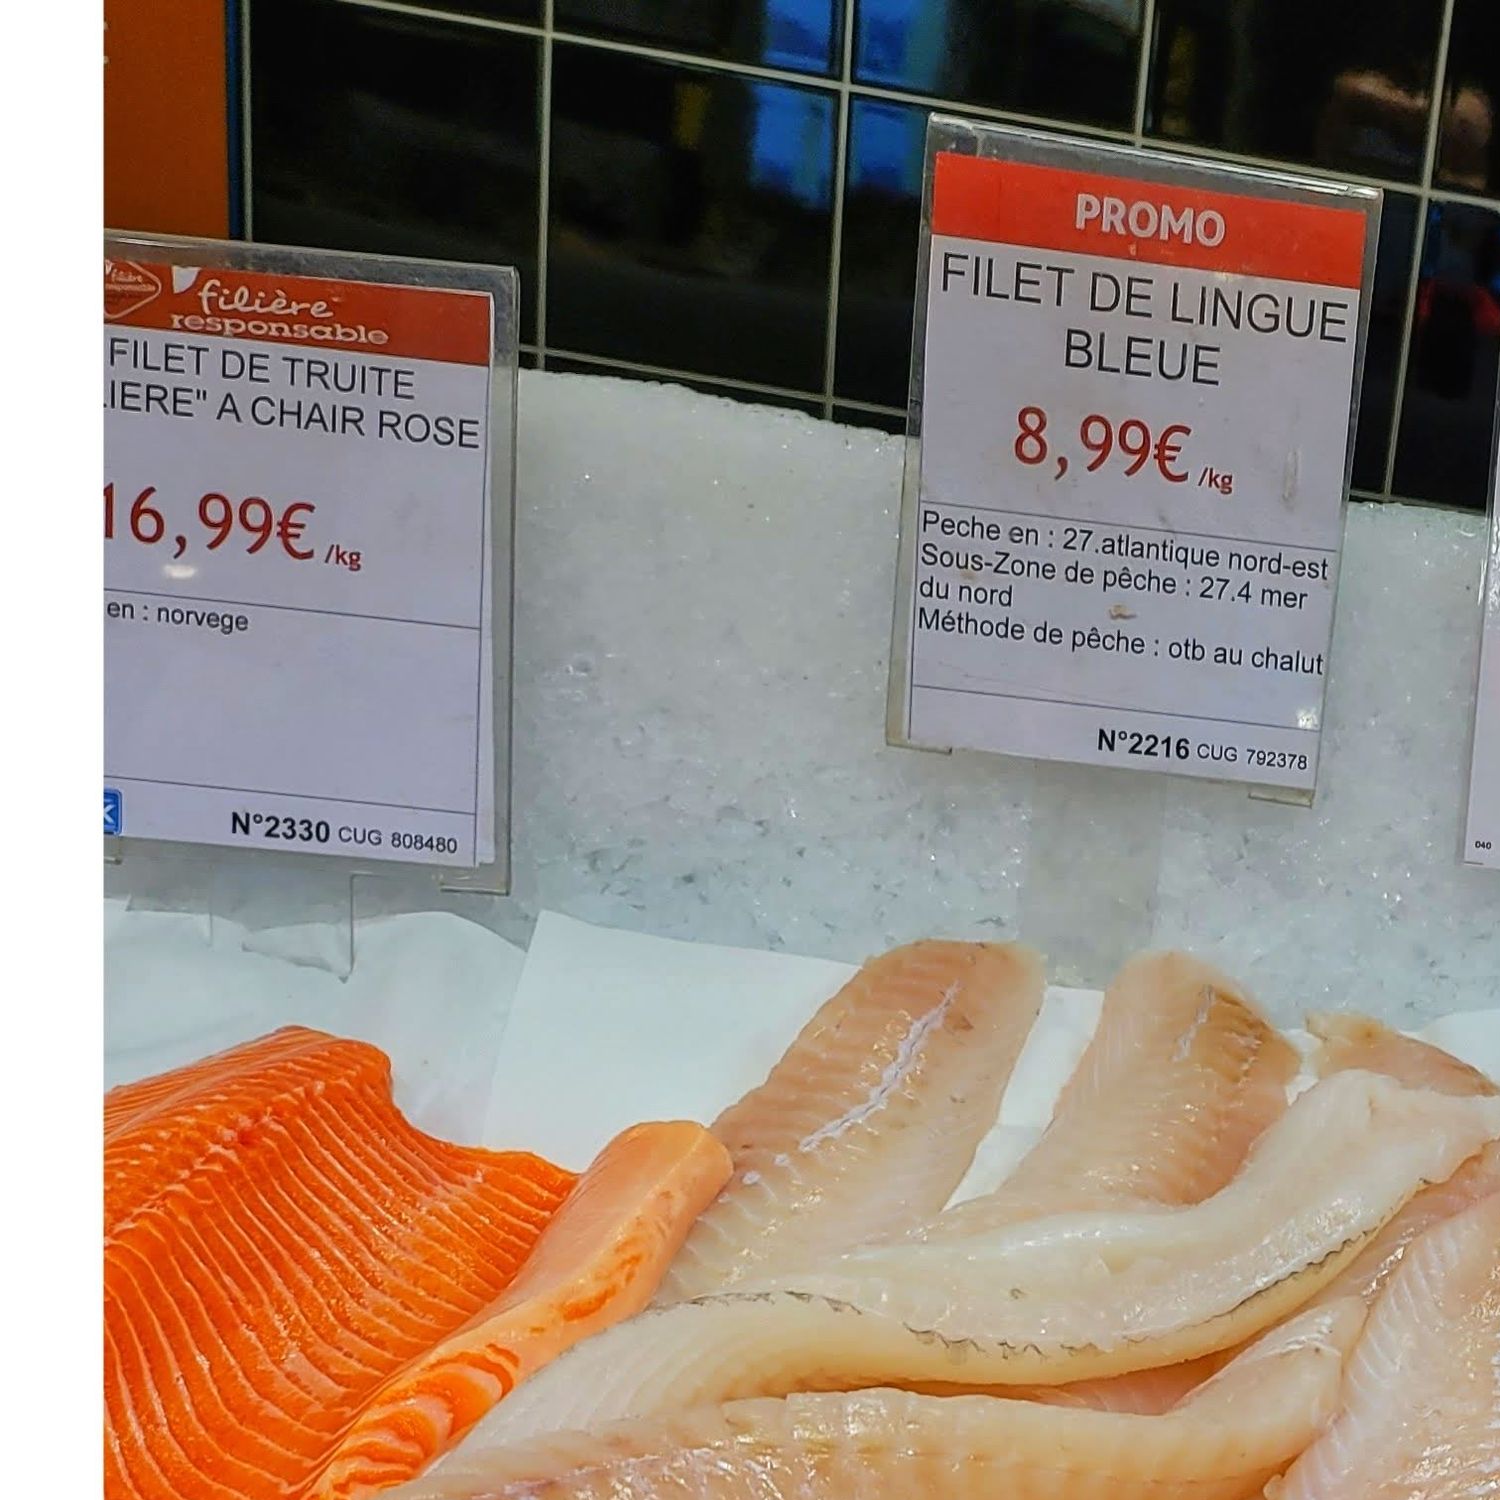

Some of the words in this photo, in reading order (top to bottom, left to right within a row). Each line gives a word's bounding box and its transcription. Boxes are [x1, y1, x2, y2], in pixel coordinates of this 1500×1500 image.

[1075, 193, 1225, 247] PROMO
[197, 279, 335, 318] filière
[942, 252, 1074, 307] FILET
[1090, 272, 1153, 318] DE
[1171, 283, 1348, 343] LINGUE
[170, 313, 388, 345] responsable
[1065, 329, 1220, 386] BLEUE
[110, 337, 209, 376] FILET
[221, 349, 270, 384] DE
[282, 357, 415, 400] TRUITE
[104, 380, 207, 417] IERE"
[216, 392, 242, 423] A
[251, 397, 365, 436] CHAIR
[378, 413, 479, 449] ROSE
[1014, 406, 1192, 483] 8,99€
[1198, 467, 1233, 495] /kg
[103, 482, 316, 559] 16,99€
[324, 544, 361, 571] /kg
[922, 511, 1000, 540] Peche
[1010, 526, 1040, 545] en
[1048, 530, 1054, 548] :
[1229, 550, 1328, 580] nord-est
[919, 577, 948, 600] du
[959, 585, 1013, 607] nord
[921, 543, 1056, 580] Sous-Zone
[1065, 560, 1094, 585] de
[1103, 567, 1176, 596] pêche
[1185, 579, 1191, 597] :
[1200, 577, 1251, 604] 27.4
[1261, 588, 1308, 610] mer
[107, 601, 135, 620] en
[143, 605, 148, 620] :
[157, 608, 248, 634] norvege
[919, 607, 1025, 641] Méthode
[1034, 620, 1063, 645] de
[1072, 625, 1145, 655] pêche
[1154, 639, 1159, 656] :
[1168, 638, 1205, 661] otb
[1214, 648, 1243, 666] au
[1251, 648, 1323, 675] chalut
[1098, 728, 1190, 760] N°2216
[1197, 743, 1237, 763] CUG
[1246, 749, 1308, 771] 792378
[231, 812, 330, 843] N°2330
[339, 826, 382, 846] CUG
[391, 832, 458, 854] 808480
